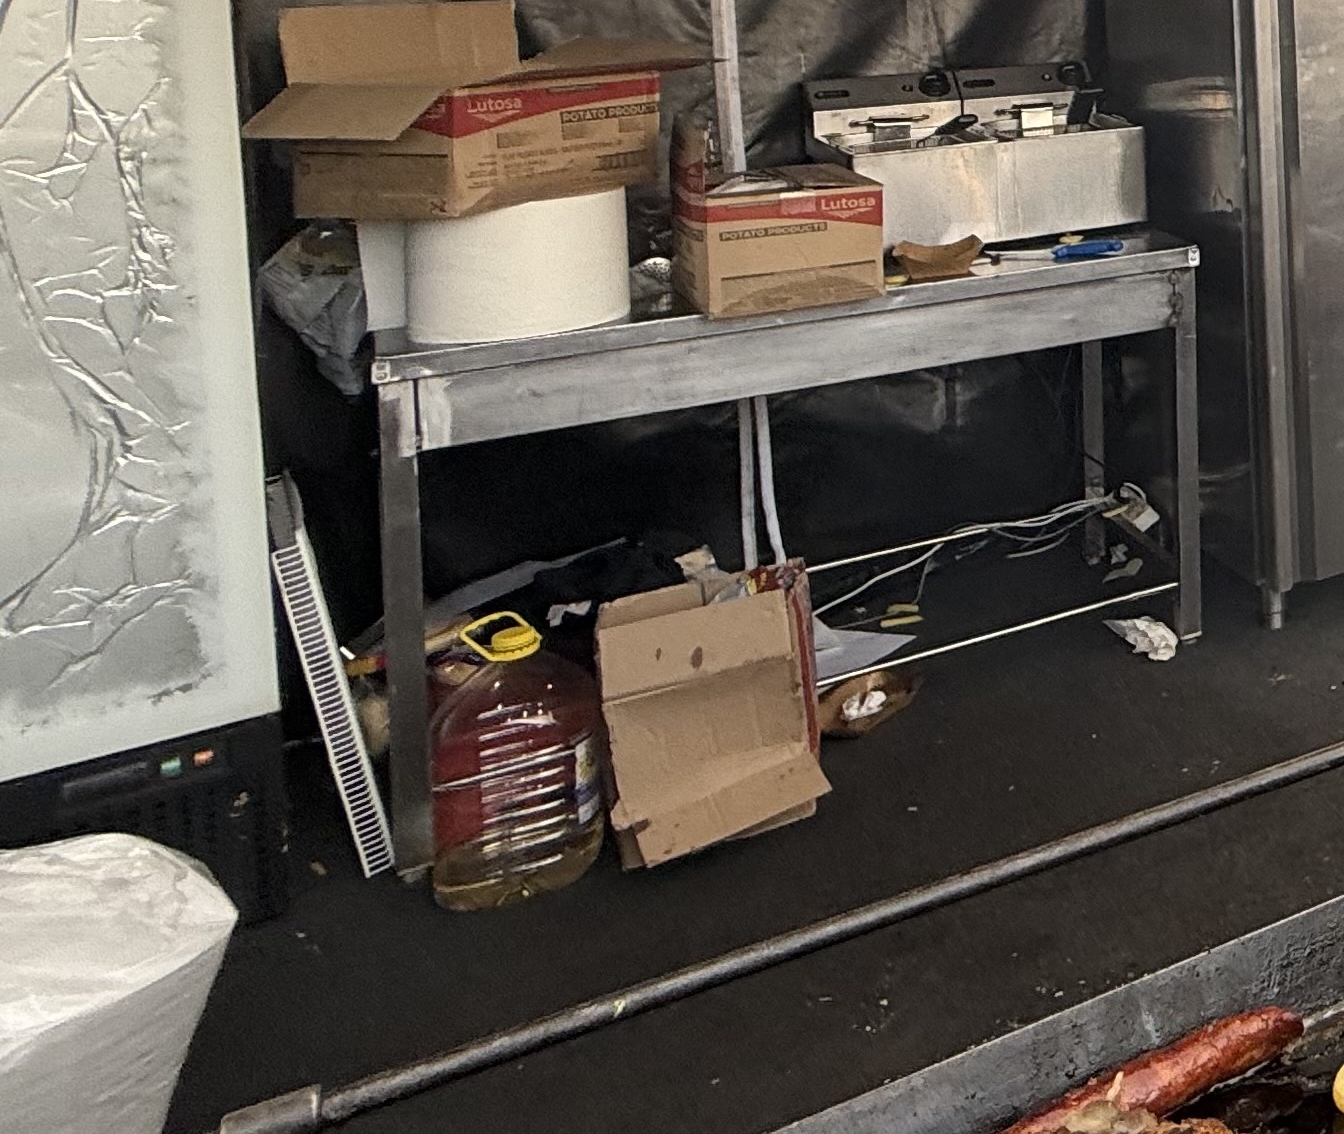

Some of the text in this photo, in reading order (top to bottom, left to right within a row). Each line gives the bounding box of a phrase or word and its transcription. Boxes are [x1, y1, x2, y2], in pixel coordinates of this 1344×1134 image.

[467, 97, 522, 114] Lutosa
[562, 109, 607, 124] POTATO
[820, 196, 876, 212] Lutosa
[721, 222, 827, 241] POTATO PRODUCTS
